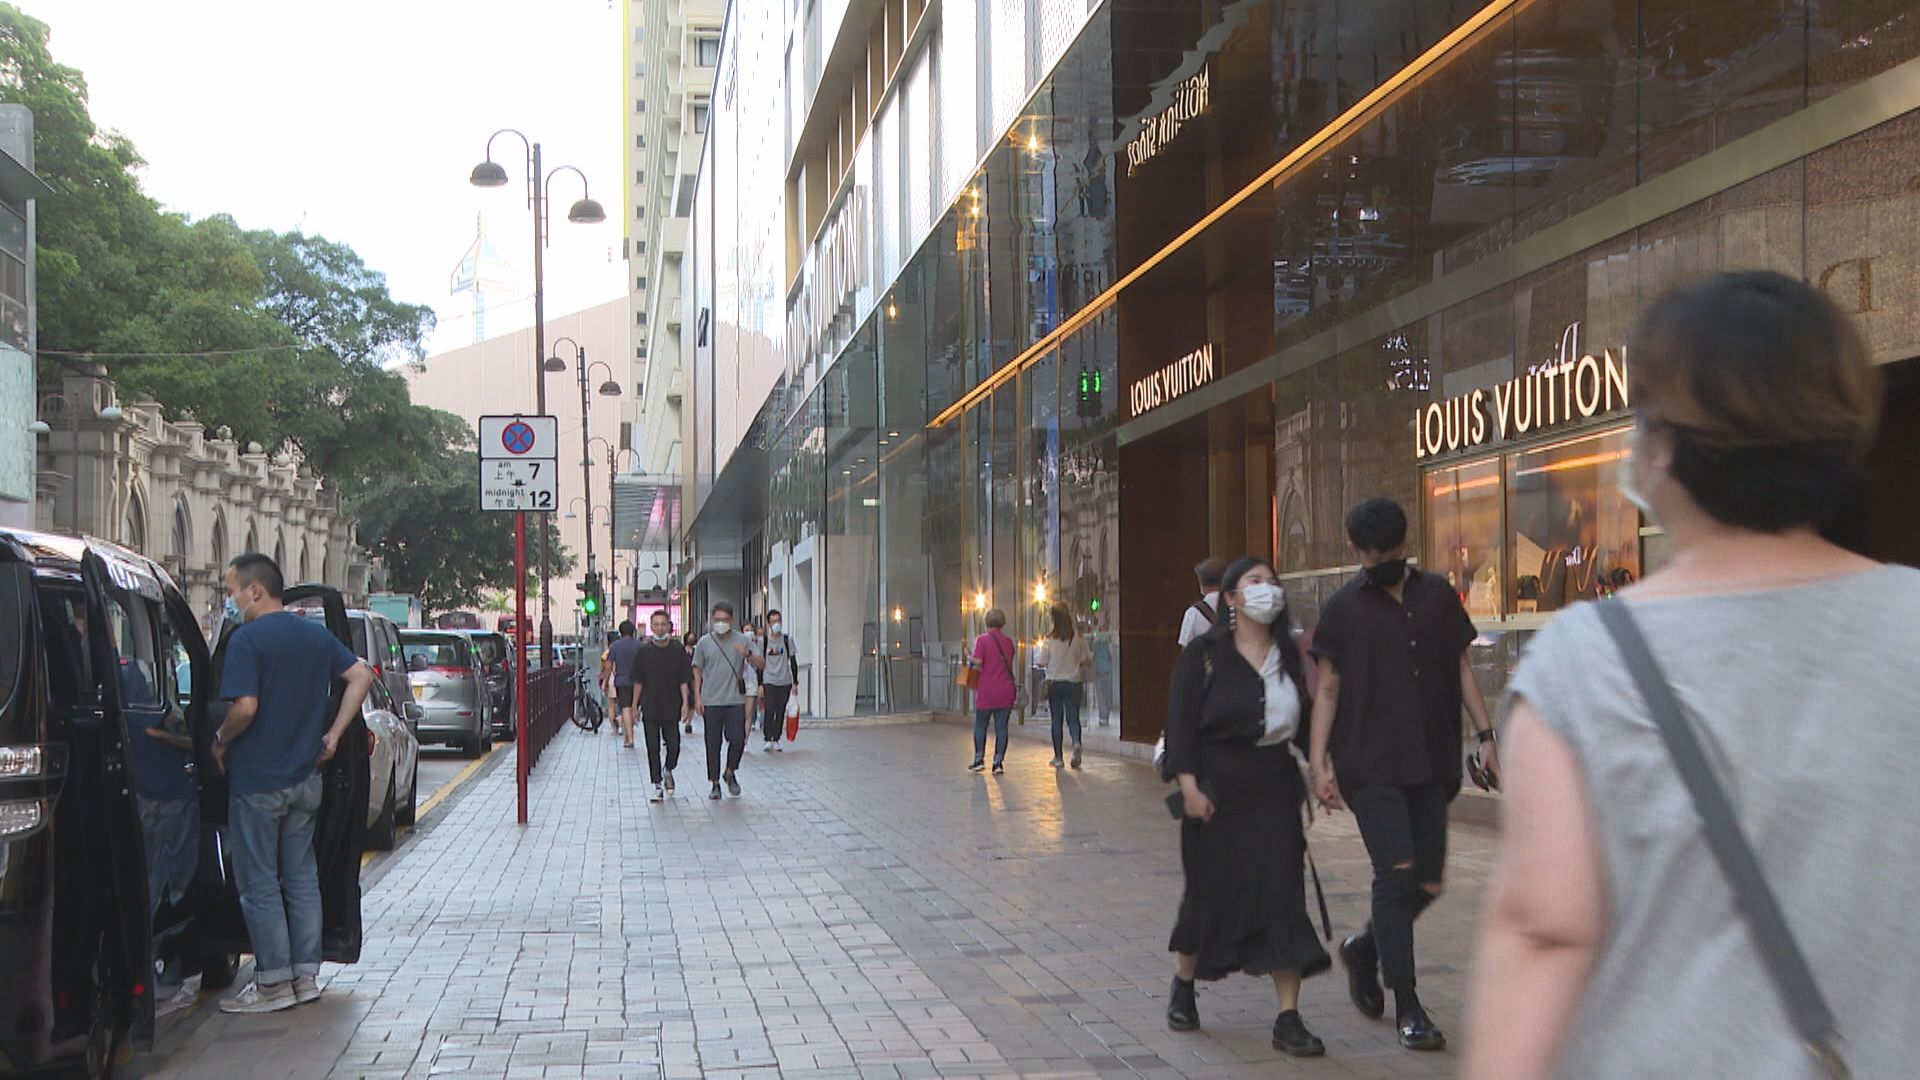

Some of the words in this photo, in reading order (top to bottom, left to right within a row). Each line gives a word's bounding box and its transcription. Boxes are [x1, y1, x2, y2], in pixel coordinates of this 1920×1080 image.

[1130, 370, 1161, 418] LOUIS
[1162, 342, 1213, 403] VUITTON
[1416, 389, 1485, 458] LOUIS
[1495, 345, 1628, 439] VUITTON
[494, 470, 515, 480] 上午
[529, 463, 540, 480] 7
[485, 488, 525, 497] midnight
[529, 491, 551, 508] 12
